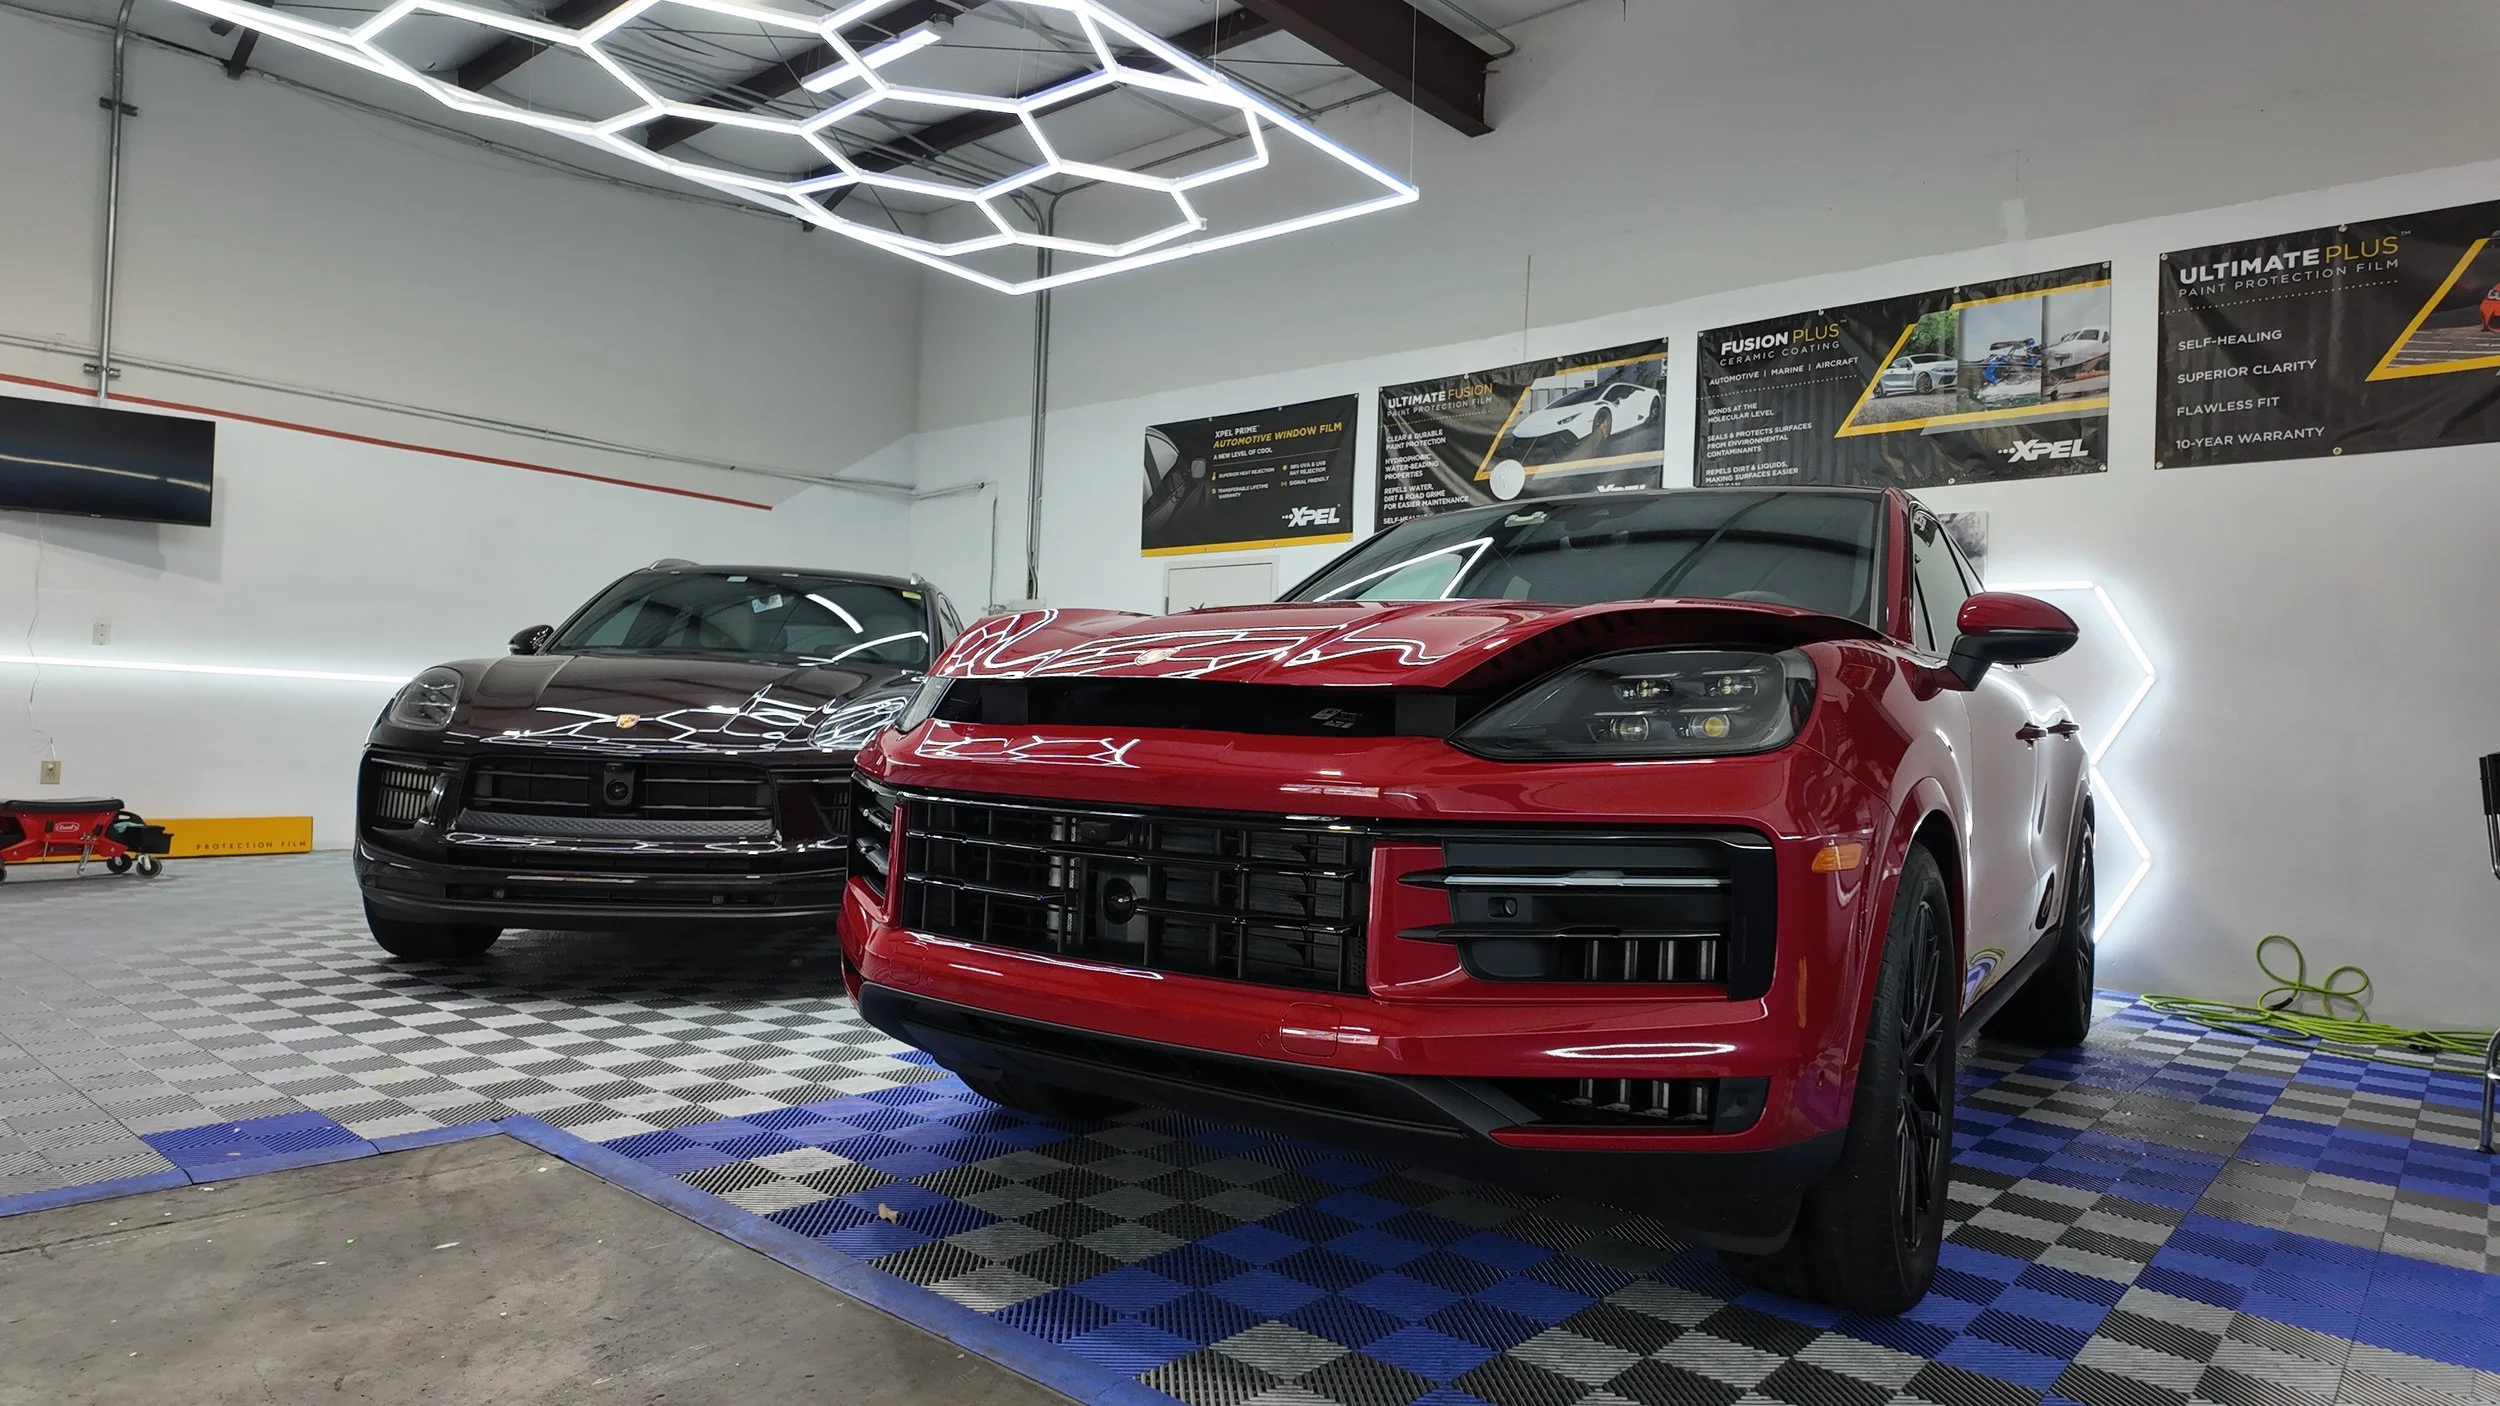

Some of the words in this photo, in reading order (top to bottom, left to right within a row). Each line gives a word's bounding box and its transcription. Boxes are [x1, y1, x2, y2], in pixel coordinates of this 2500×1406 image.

[2180, 248, 2320, 284] ULTIMATE
[2326, 236, 2399, 263] PLUS
[2179, 283, 2226, 297] PAINT
[2235, 266, 2346, 290] PROTECTION
[2356, 259, 2398, 273] FILM
[1721, 331, 1788, 356] FUSION
[1793, 323, 1839, 343] PLUS
[2178, 329, 2282, 351] SELF-HEALING
[1720, 351, 1775, 366] CERAMIC
[1782, 341, 1840, 356] COATING
[1709, 370, 1759, 386] AUTOMOTIVE
[1771, 365, 1804, 376] MARINE
[1815, 357, 1859, 369] AIRCRAFT
[2177, 366, 2248, 384] SUPERIOR
[2252, 359, 2317, 375] CLARITY
[1388, 390, 1446, 409] ULTIMATE
[1448, 383, 1493, 400] FUSION
[1387, 408, 1410, 417] PAINT
[1413, 401, 1468, 413] PROTECTION
[1471, 396, 1492, 406] FILM
[1708, 407, 1732, 416] BONDS
[2177, 399, 2253, 416] FLAWLESS
[2257, 397, 2280, 408] FIT
[1707, 411, 1749, 424] MOLECULAR
[1751, 409, 1775, 418] LEVEL
[1213, 433, 1272, 449] AUTOMOTIVE
[1274, 426, 1317, 440] WINDOW
[1319, 422, 1342, 434] FILM
[1214, 430, 1233, 439] XPEL
[1235, 425, 1257, 436] PRIME
[1386, 434, 1406, 443] CLEAR
[1414, 429, 1443, 439] DURABLE
[1707, 433, 1728, 442] SEALS
[1735, 428, 1773, 438] PROTECTS
[1774, 423, 1812, 433] SURFACES
[2176, 435, 2234, 449] 10-YEAR
[2238, 426, 2325, 443] WARRANTY
[1405, 437, 1446, 448] PROTECTION
[1707, 442, 1726, 450] FROM
[1727, 435, 1789, 447] ENVIRONMENTAL
[1218, 452, 1231, 460] NEW
[1231, 450, 1247, 458] LEVEL
[1706, 446, 1762, 458] CONTAMINANTS
[2008, 438, 2089, 463] XPEL
[1385, 454, 1431, 464] HYDROPHOBIC
[1385, 461, 1439, 472] WATER-BEADING
[1384, 470, 1423, 480] PROPERTIES
[1705, 467, 1732, 476] REPELS
[1733, 465, 1750, 473] DIRT
[1757, 461, 1788, 470] LIQUIDS,
[1705, 474, 1733, 483] MAKING
[1734, 471, 1771, 480] SURFACES
[1772, 467, 1799, 476] EASIER
[1384, 486, 1408, 495] REPELS
[1405, 492, 1424, 500] ROAD
[1425, 490, 1446, 498] GRIME
[1397, 500, 1420, 509] EASIER
[1422, 495, 1469, 507] MAINTENANCE
[1288, 506, 1340, 527] XPEL
[196, 841, 272, 850] PROTECTION
[281, 840, 306, 848] FILM
